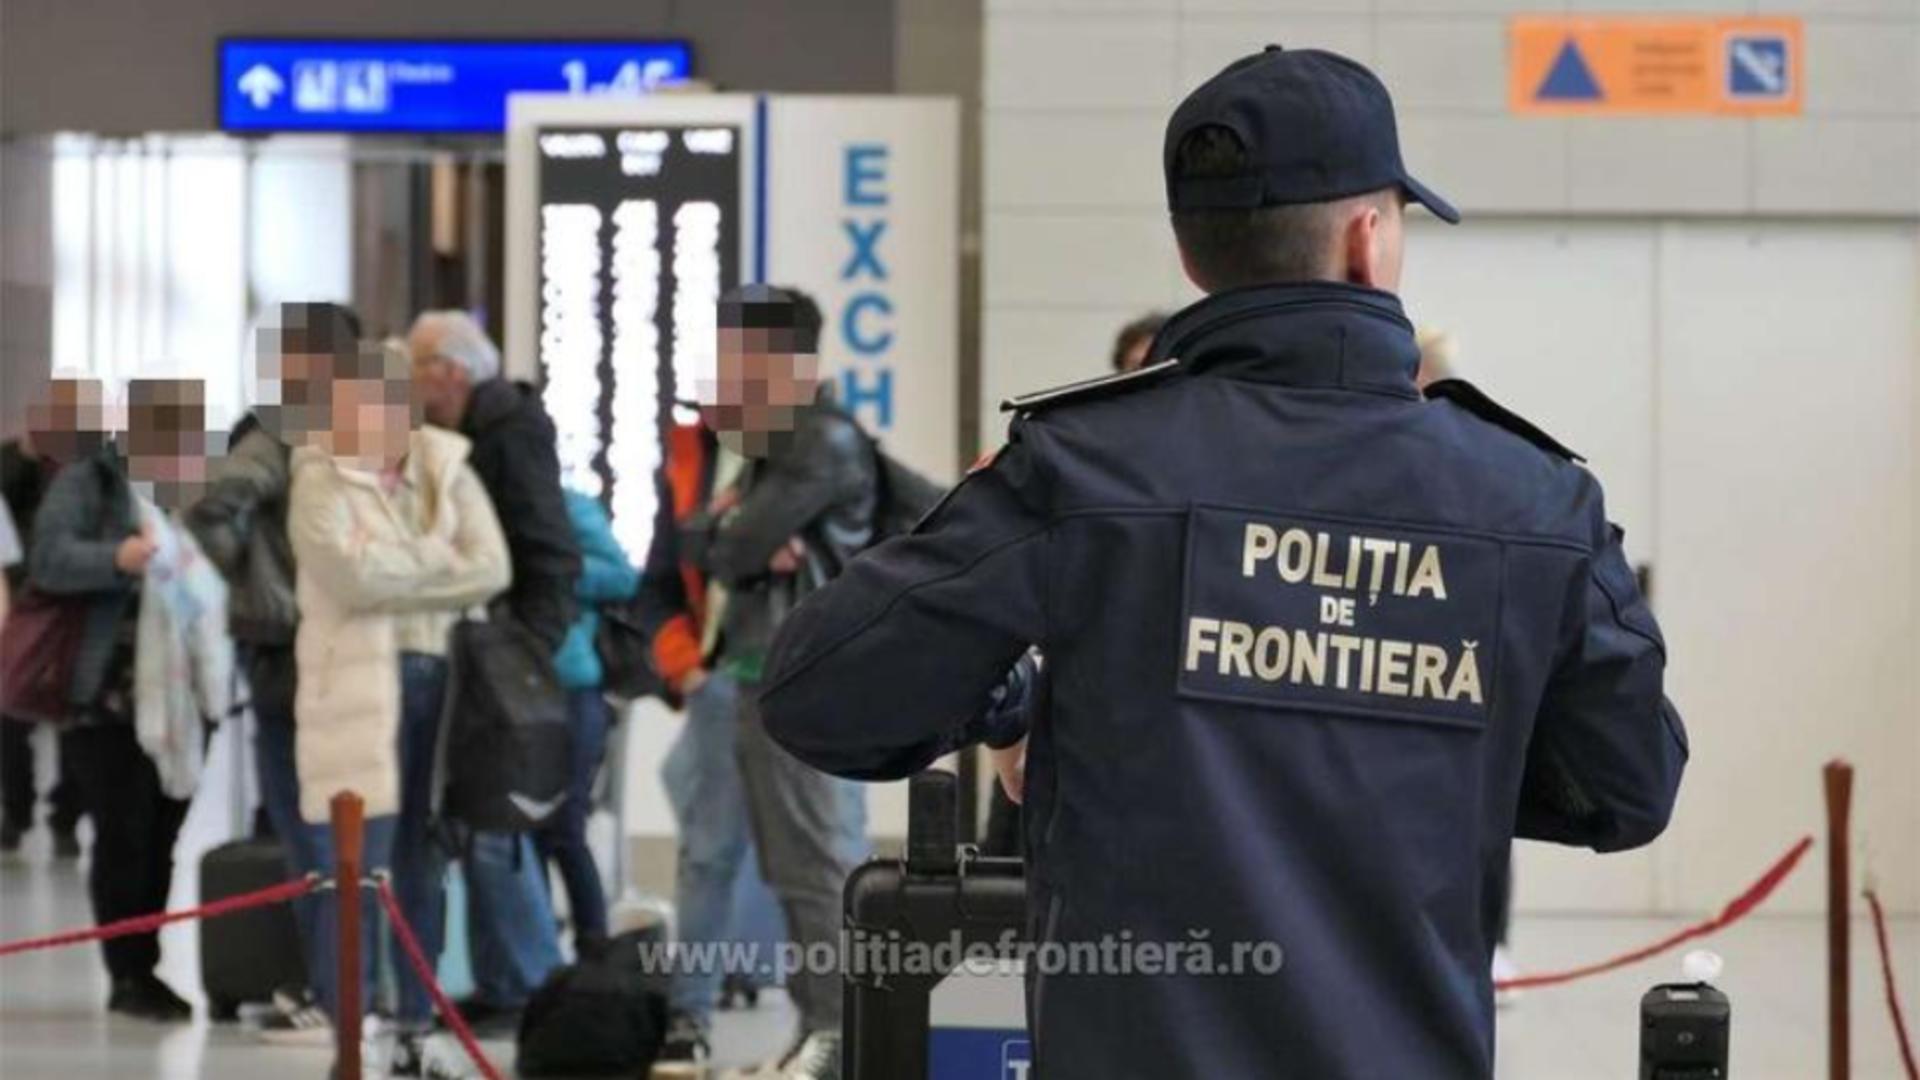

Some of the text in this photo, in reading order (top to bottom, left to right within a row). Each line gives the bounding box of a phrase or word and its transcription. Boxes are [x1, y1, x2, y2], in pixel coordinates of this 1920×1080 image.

[1243, 523, 1447, 606] POLIȚIA
[1320, 595, 1355, 626] DE
[1186, 616, 1483, 704] FRONTIERĂ
